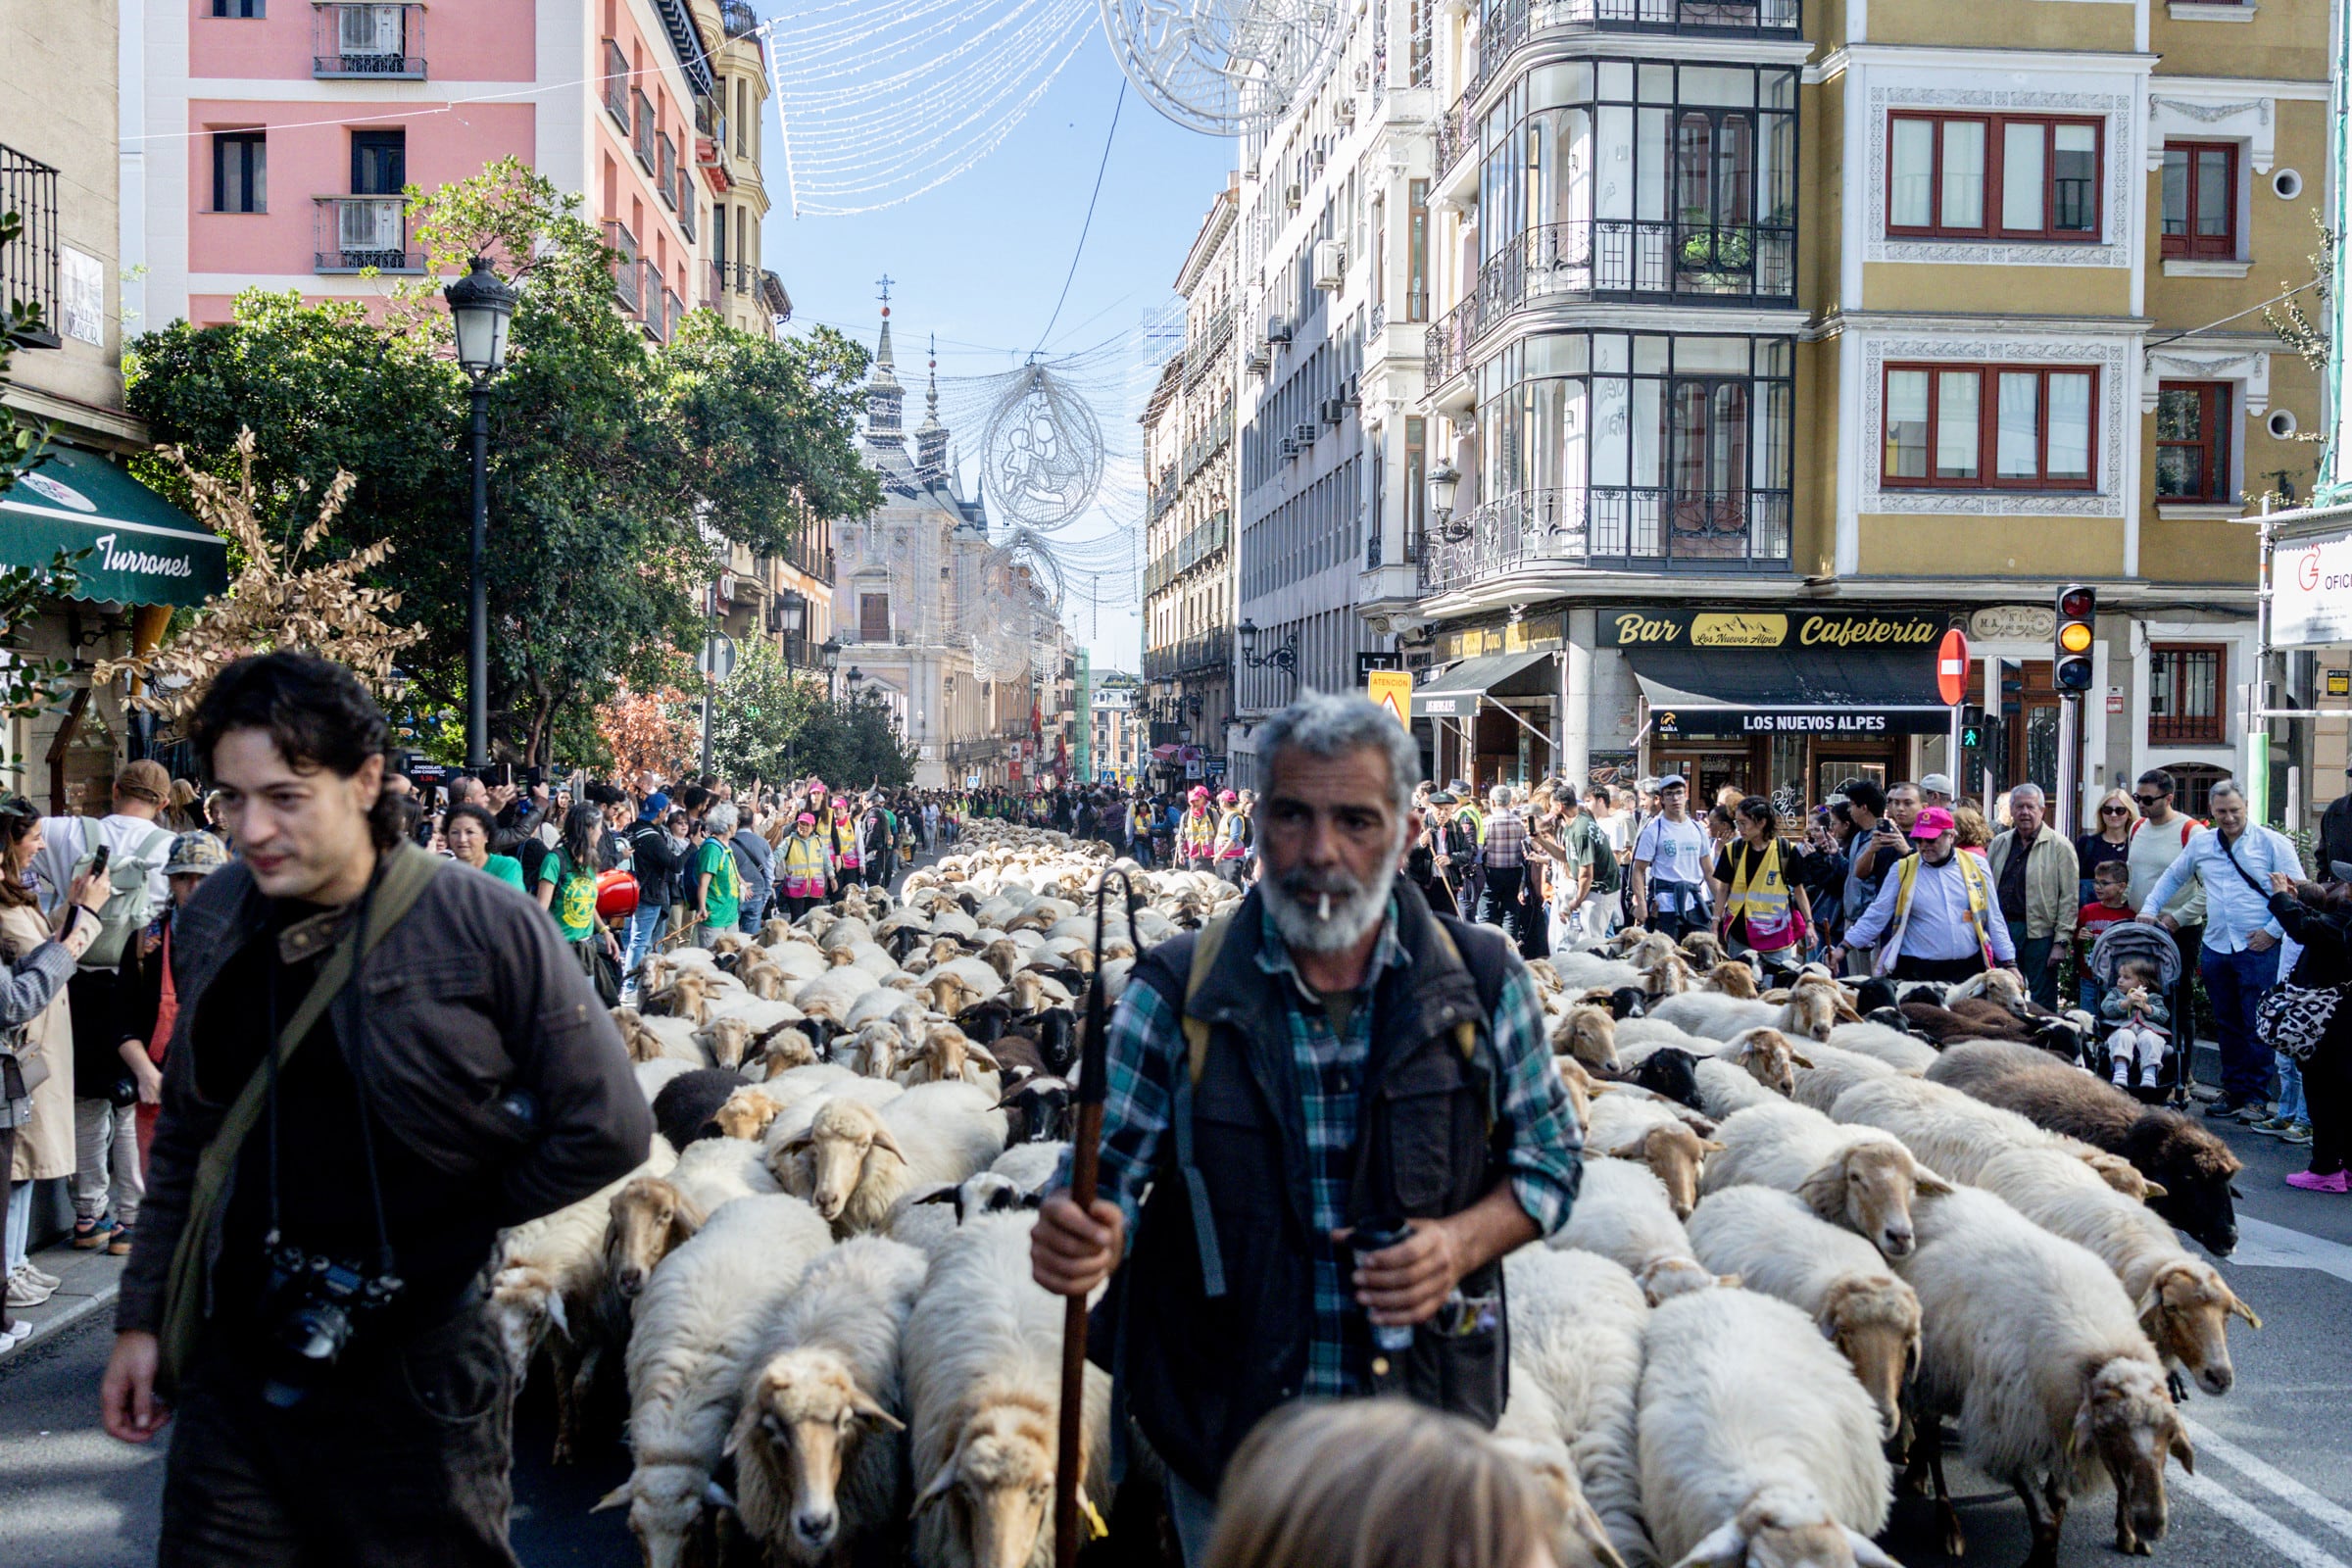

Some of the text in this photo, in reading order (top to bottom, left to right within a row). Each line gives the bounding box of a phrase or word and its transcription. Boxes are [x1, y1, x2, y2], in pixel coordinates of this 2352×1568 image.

[68, 316, 100, 346] MAYOR
[96, 532, 192, 577] Turrones
[1615, 612, 1683, 644] Bar
[1694, 634, 1778, 647] Los Nuevos Alpes
[1799, 615, 1938, 647] Cafetería
[1373, 677, 1408, 688] ATENCIÓN
[1743, 716, 1886, 731] LOS NUEVOS ALPES
